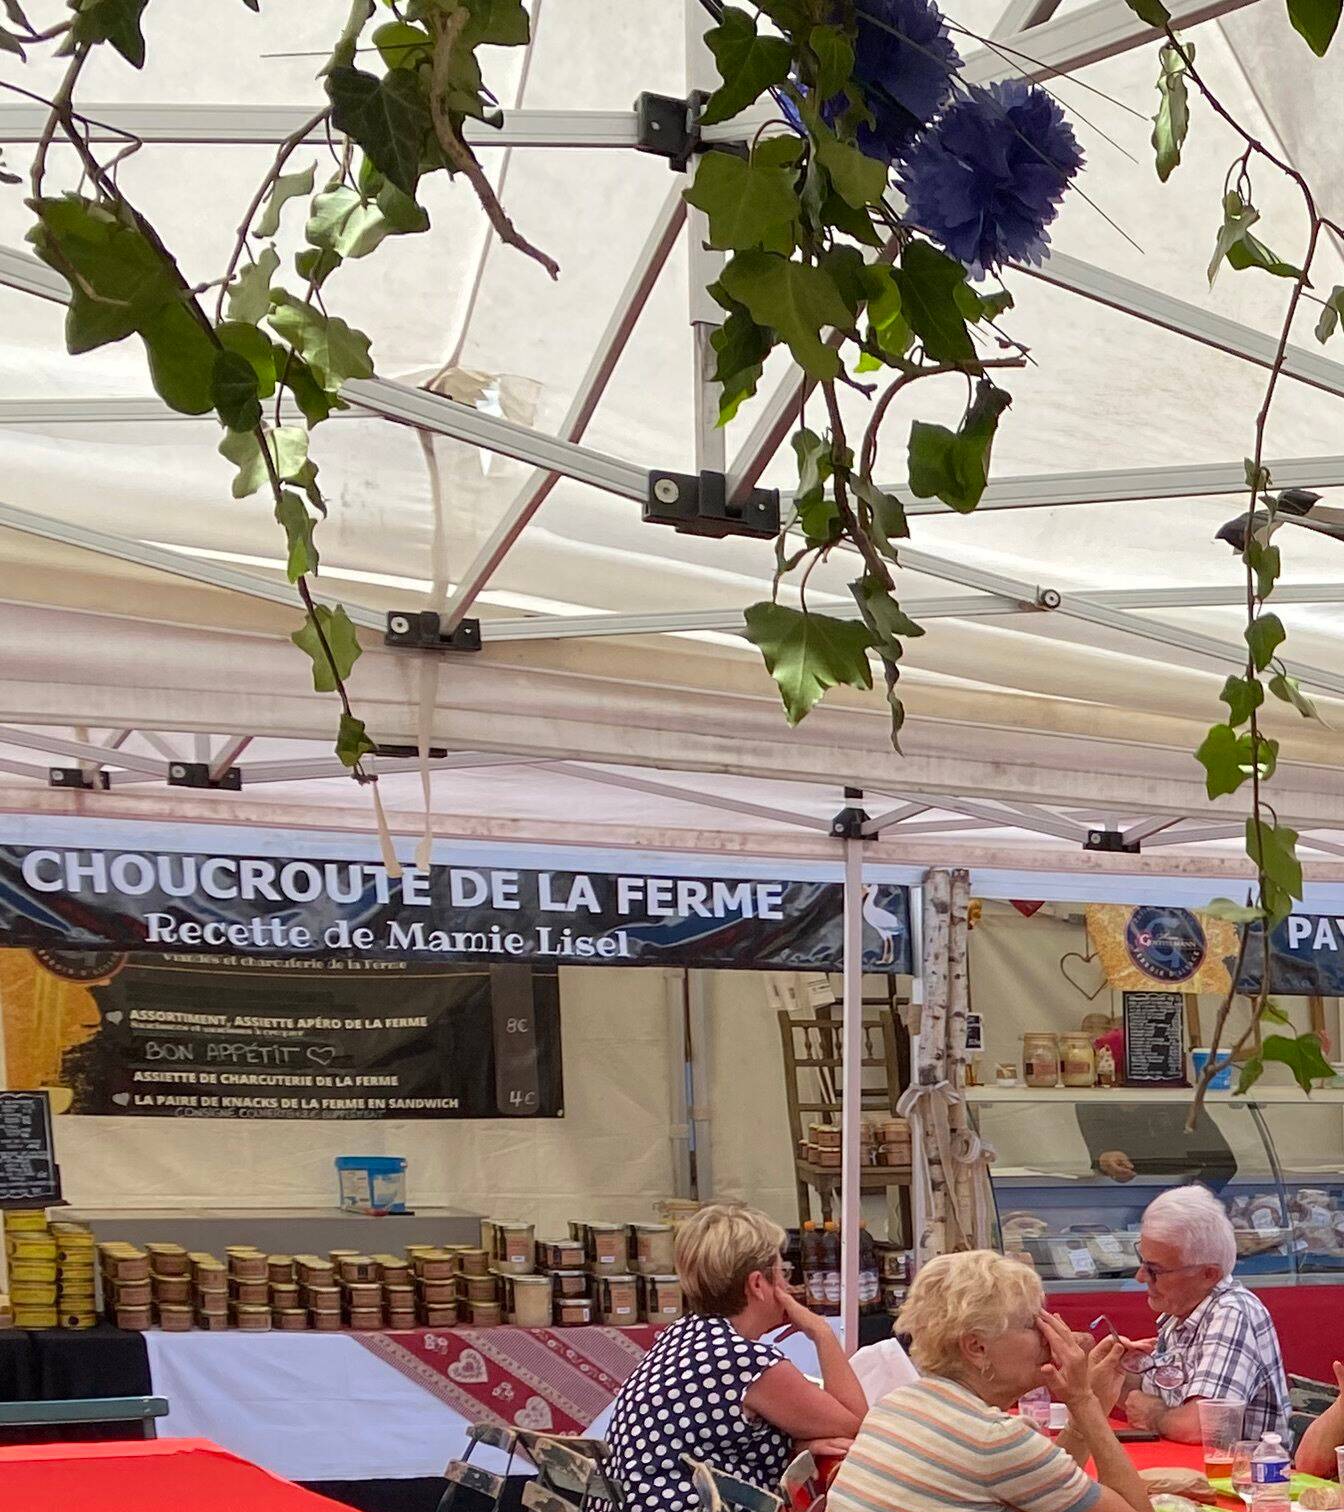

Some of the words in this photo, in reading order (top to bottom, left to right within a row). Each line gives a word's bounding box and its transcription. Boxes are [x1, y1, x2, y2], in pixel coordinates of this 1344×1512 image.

[22, 849, 431, 906] CHOUCROUTE
[451, 869, 520, 910] DE
[539, 873, 601, 913] LA
[618, 877, 783, 920] FERME
[144, 913, 310, 947] Recette
[324, 919, 375, 950] de
[386, 920, 524, 954] Mamie
[535, 927, 633, 957] Lisel
[234, 1015, 294, 1028] ASSIETTE
[297, 1015, 342, 1029] APÉRO
[345, 1018, 362, 1029] DE
[365, 1018, 382, 1028] LA
[385, 1016, 428, 1028] FERME
[145, 1041, 193, 1060] BON
[133, 1071, 196, 1083] ASSIETTE
[200, 1073, 216, 1083] DE
[220, 1074, 312, 1086] CHARCUTERIE
[316, 1076, 333, 1086] DE
[336, 1076, 352, 1087] LA
[356, 1075, 399, 1086] FERME
[134, 1094, 150, 1106] LA
[157, 1095, 197, 1107] PAIRE
[201, 1096, 218, 1107] DE
[222, 1096, 277, 1108] KNACKS
[281, 1097, 298, 1109] DE
[301, 1097, 319, 1109] LA
[322, 1098, 365, 1109] FERME
[368, 1098, 385, 1109] EN
[389, 1099, 459, 1109] SANDWICH
